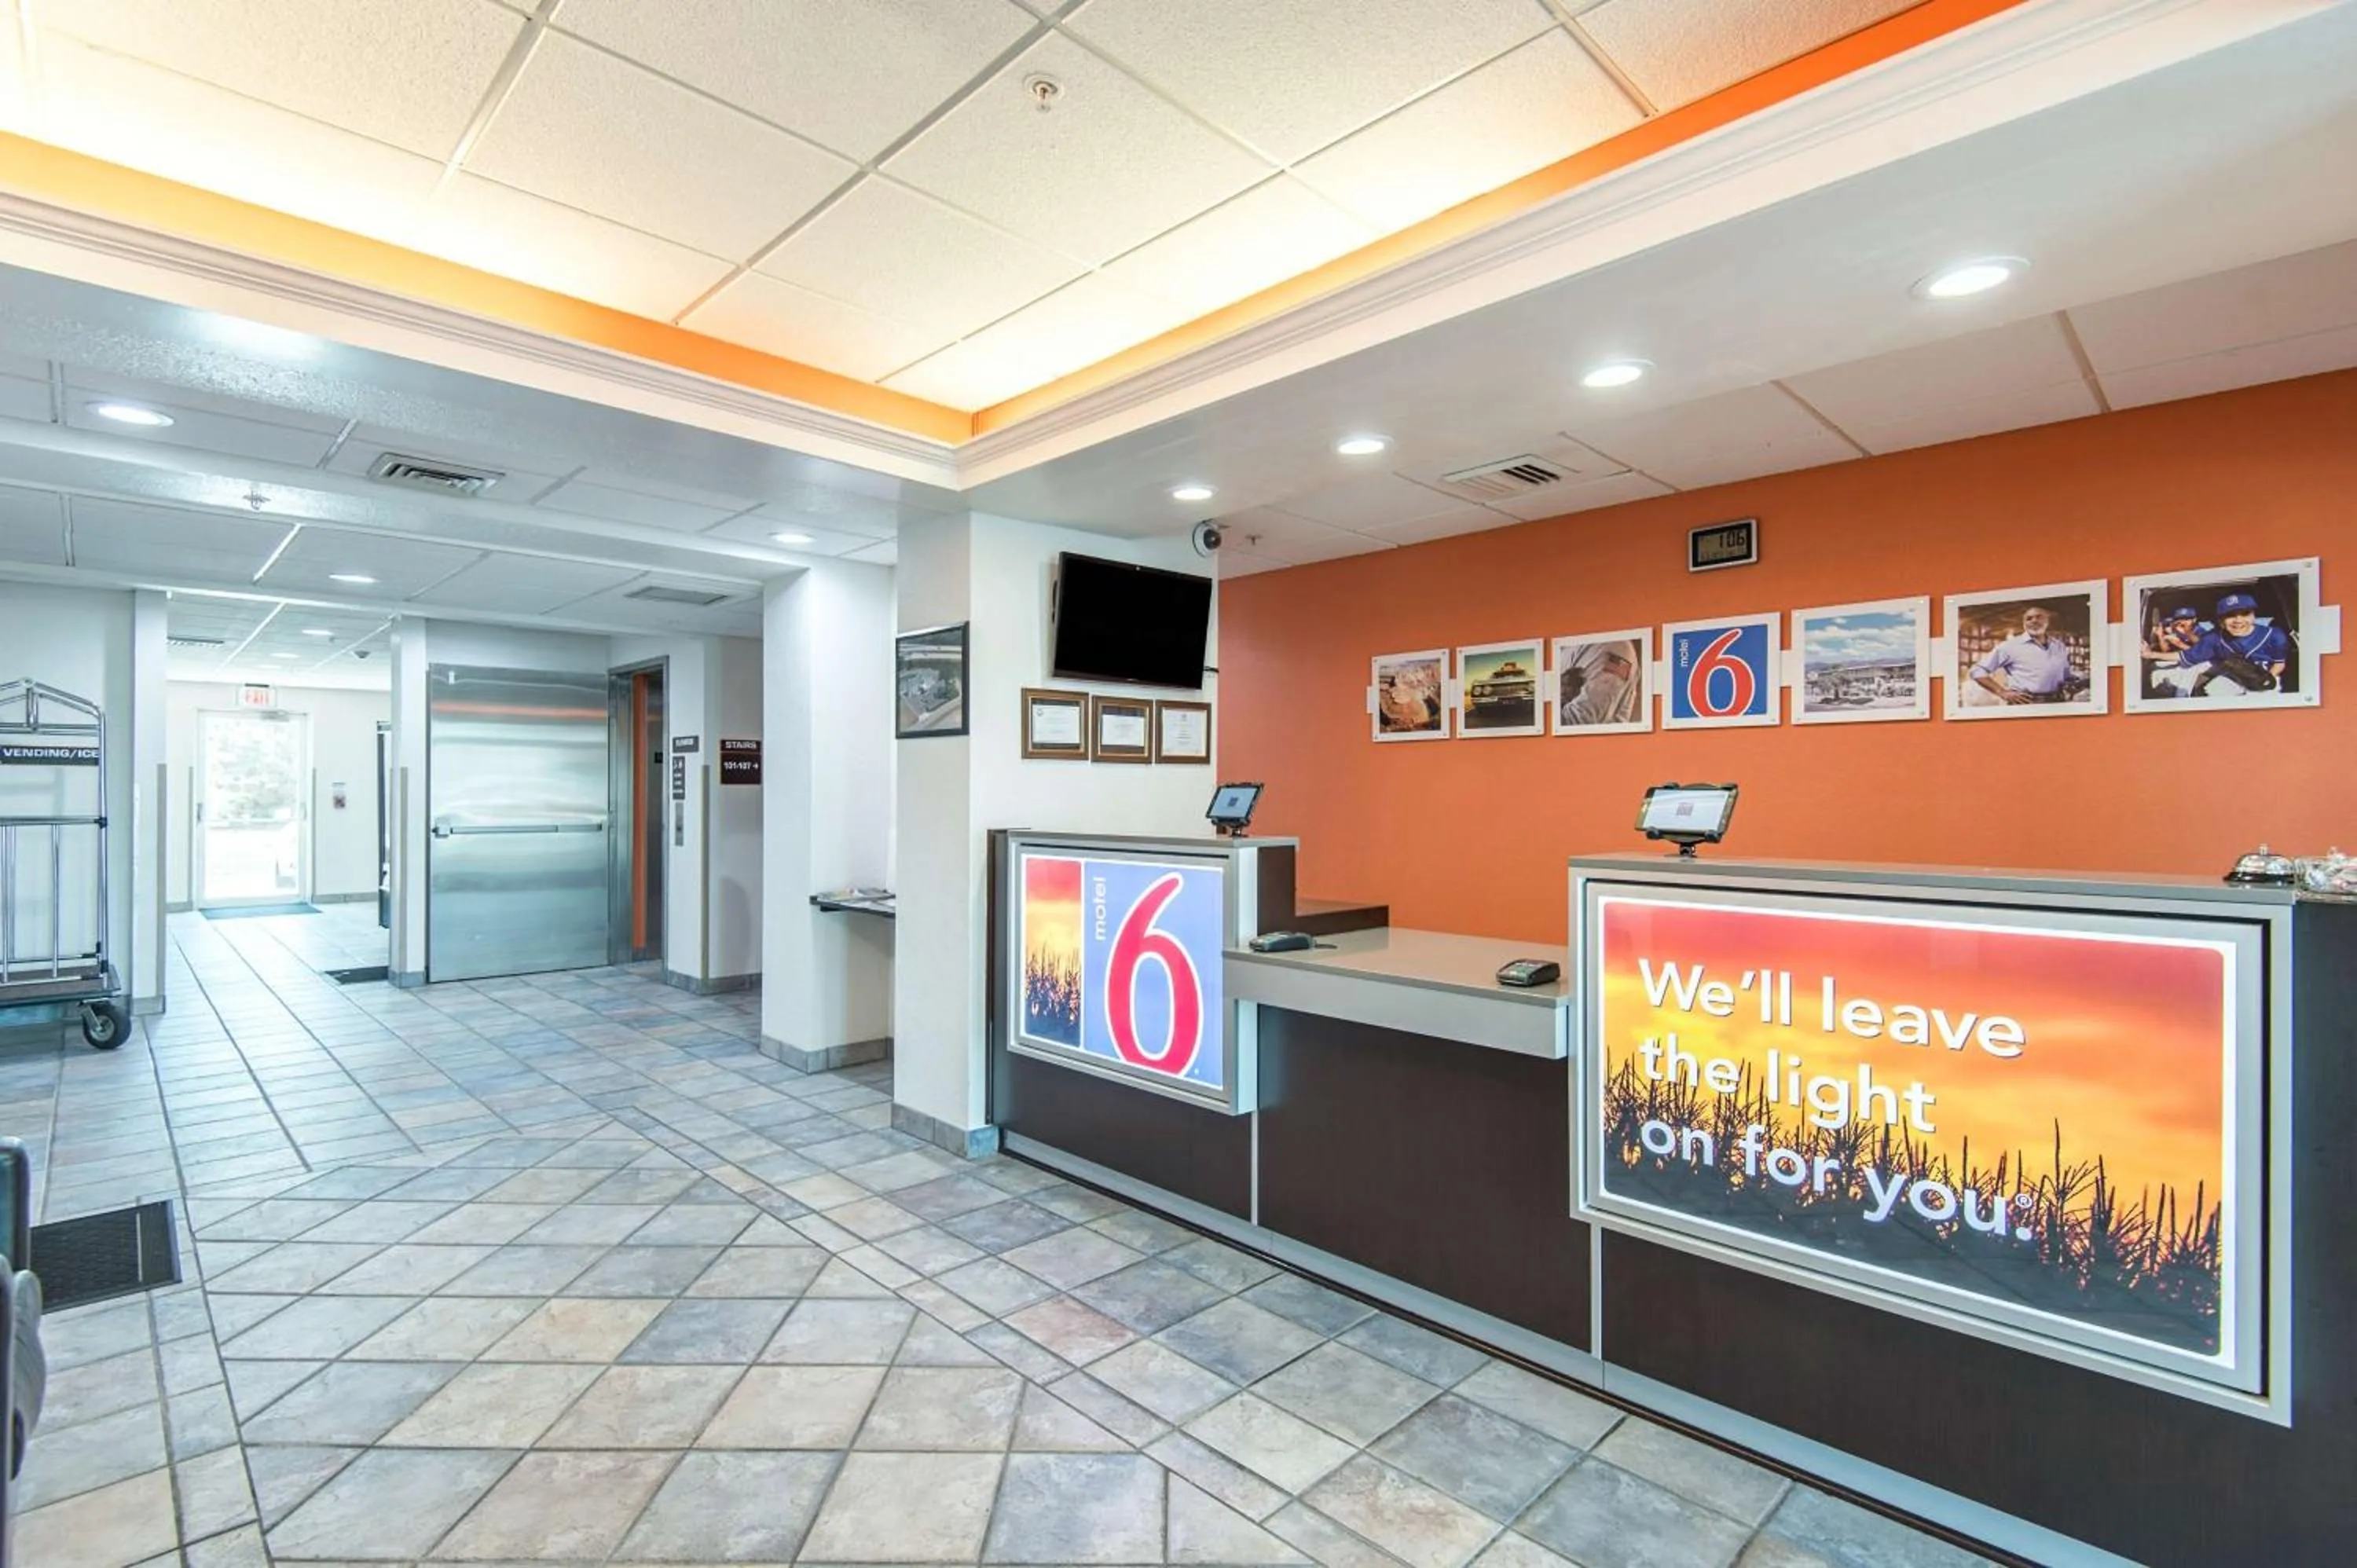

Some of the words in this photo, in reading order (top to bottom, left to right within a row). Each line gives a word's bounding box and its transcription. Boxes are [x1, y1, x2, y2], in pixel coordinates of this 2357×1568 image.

[1680, 639, 1688, 667] motel
[1688, 628, 1755, 719] 6
[3, 747, 99, 758] VENDING/ICE
[1093, 877, 1106, 940] motel
[1105, 871, 1204, 1077] 6
[1638, 958, 1792, 1025] We'll
[1822, 976, 2025, 1057] leave
[1639, 1032, 1739, 1094] the
[1767, 1048, 1936, 1132] light
[1640, 1119, 1714, 1166] on
[1739, 1124, 1840, 1192] for
